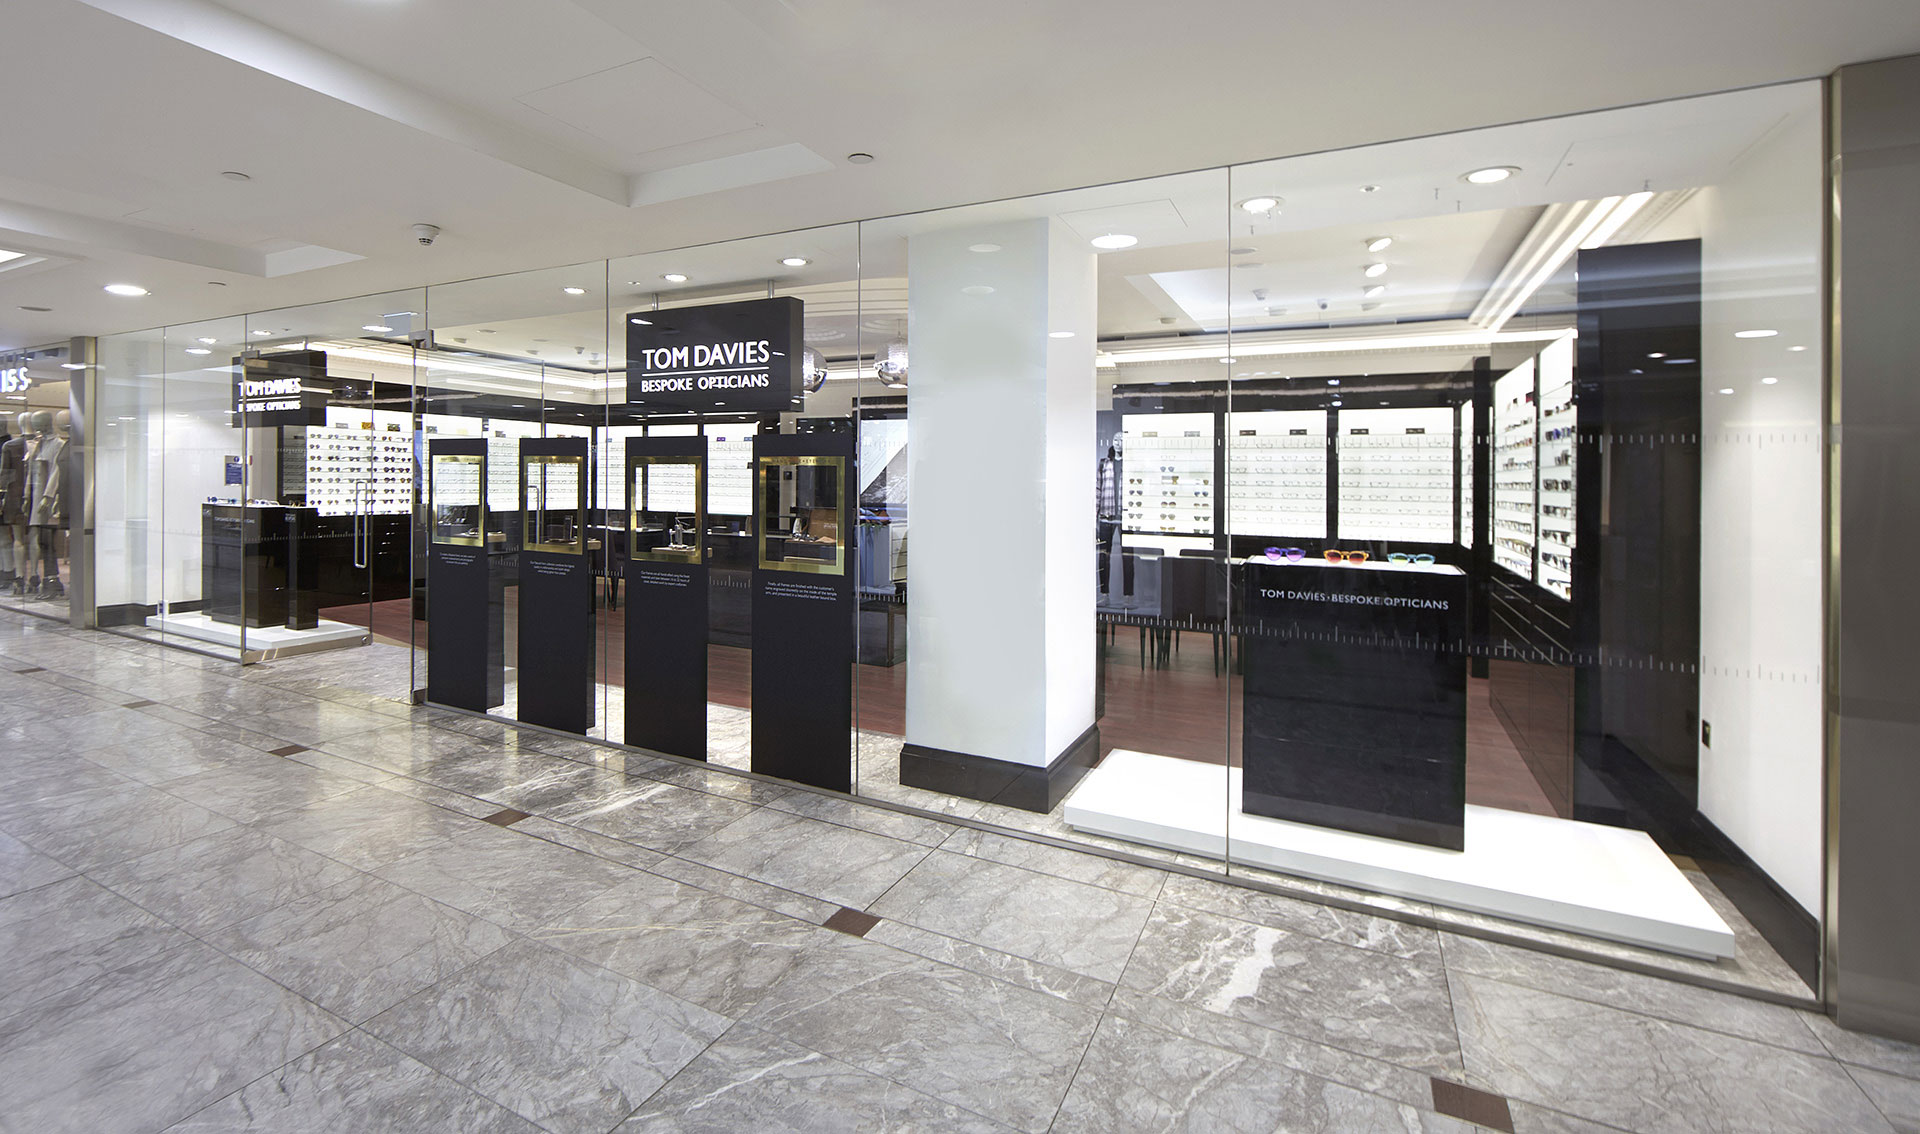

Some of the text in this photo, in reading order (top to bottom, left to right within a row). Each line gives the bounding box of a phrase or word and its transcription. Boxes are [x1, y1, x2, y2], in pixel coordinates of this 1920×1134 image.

[641, 340, 770, 370] TOM DAVIES
[641, 373, 769, 393] BESPOKE OPTICIANS
[1260, 589, 1449, 611] TOM DAVIES BESPOKE OPTICIANS
